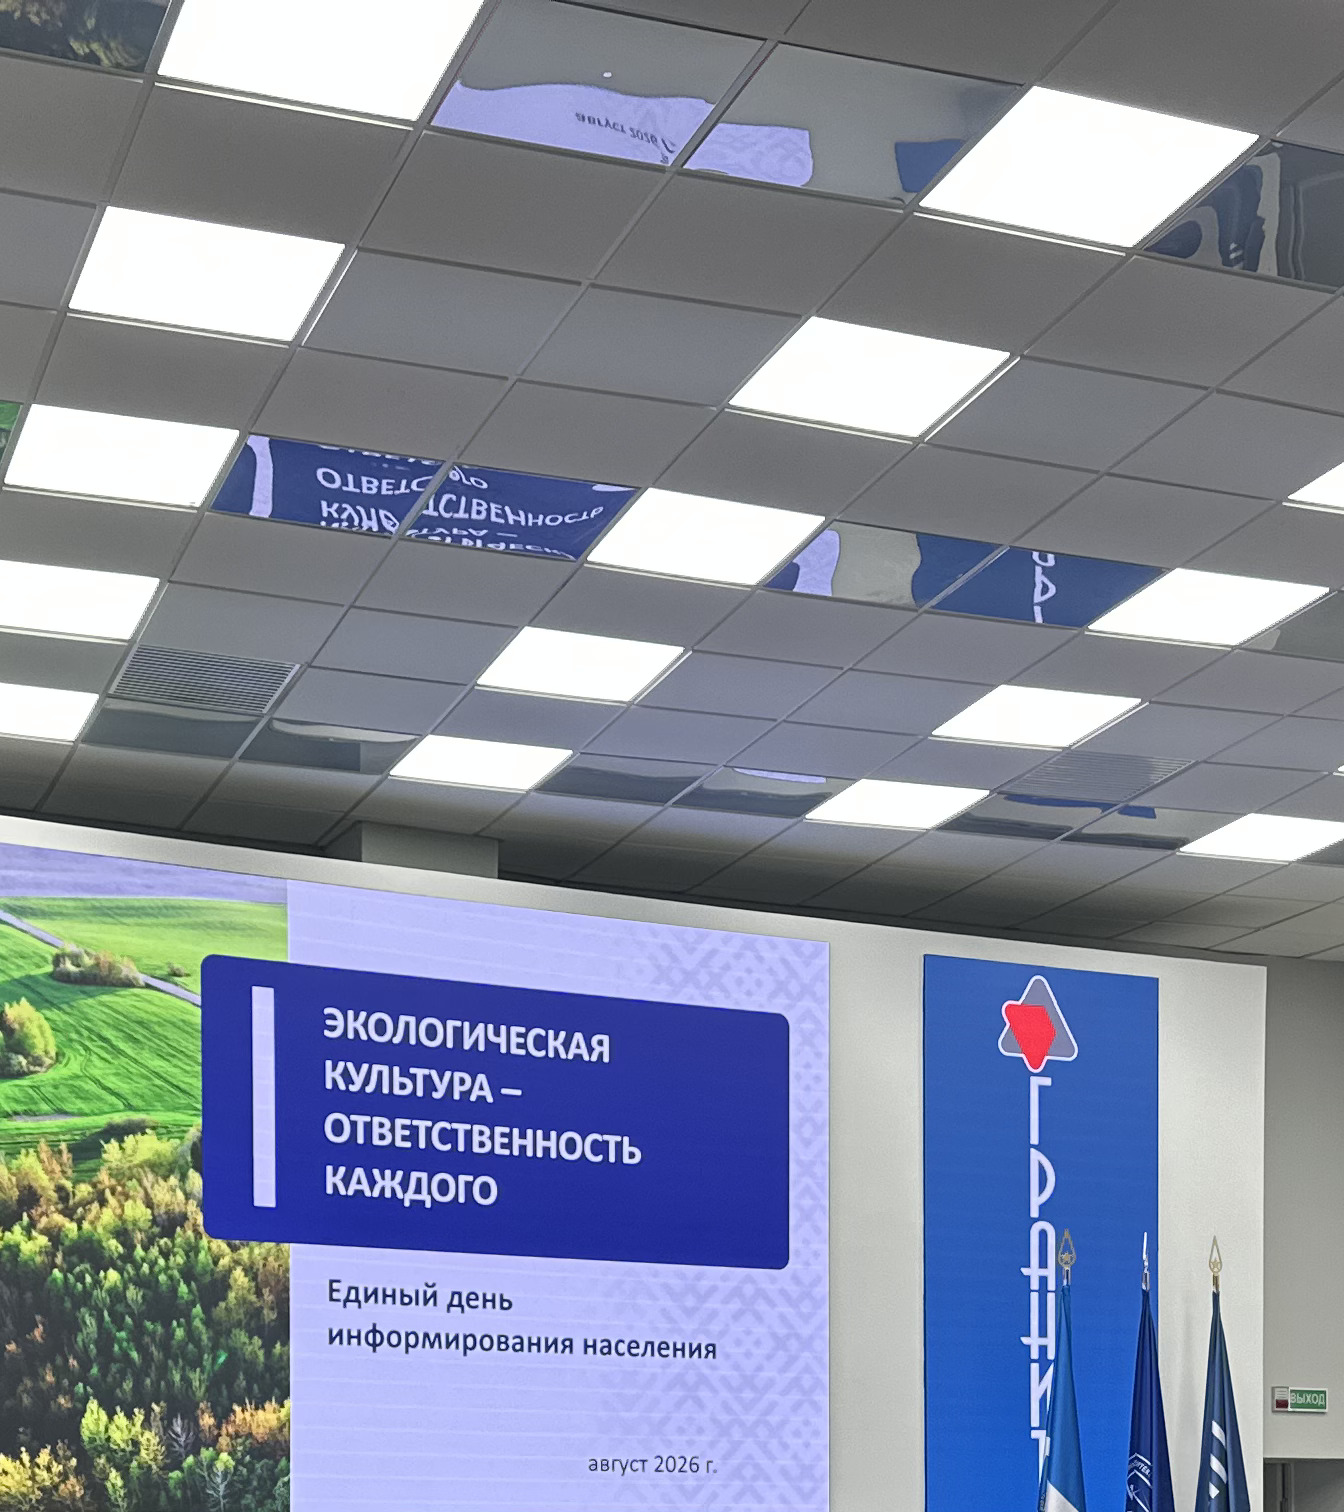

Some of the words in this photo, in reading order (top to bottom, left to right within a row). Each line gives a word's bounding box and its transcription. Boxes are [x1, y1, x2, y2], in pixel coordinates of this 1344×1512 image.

[323, 1007, 610, 1063] ЭКОЛОГИЧЕСКАЯ
[325, 1059, 494, 1103] КУЛЬТУРА
[323, 1112, 642, 1165] ОТВЕТСТВЕННОСТЬ
[325, 1164, 498, 1209] КАЖДОГО
[327, 1278, 438, 1309] Единый
[447, 1289, 513, 1314] день
[327, 1323, 574, 1356] информирования
[582, 1336, 717, 1360] населения
[1290, 1392, 1325, 1407] ВЫХОД
[588, 1458, 649, 1476] август
[654, 1455, 700, 1473] 2026
[706, 1460, 718, 1473] г.
